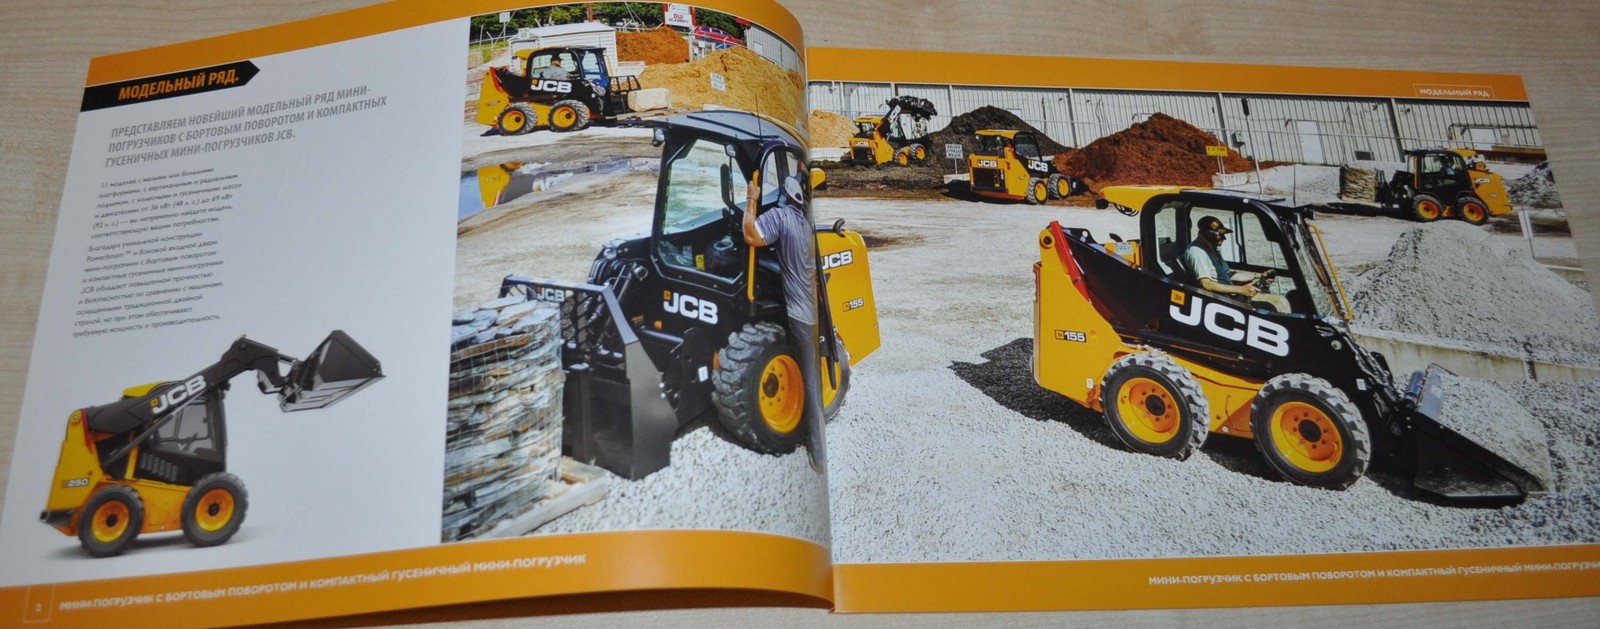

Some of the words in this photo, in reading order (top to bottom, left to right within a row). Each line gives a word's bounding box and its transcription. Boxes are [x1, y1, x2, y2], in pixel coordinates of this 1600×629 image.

[118, 74, 204, 101] МОДЕЛЬНЫЙ
[208, 68, 238, 86] РЯД.
[531, 80, 572, 93] JCB
[111, 116, 185, 138] ПРЕДСТАВЛЯЕМ
[188, 105, 244, 126] НОВЕЙШИЙ
[246, 94, 312, 116] МОДЕЛЬНЫЙ
[314, 91, 334, 105] РЯД
[336, 85, 370, 99] МИНИ-
[108, 132, 175, 154] ПОГРУЗЧИКОВ
[178, 131, 184, 142] С
[186, 122, 240, 140] БОРТОВЫМ
[244, 112, 304, 130] ПОВОРОТОМ
[306, 109, 314, 119] И
[316, 97, 387, 117] КОМПАКТНЫХ
[105, 148, 168, 168] ГУСЕНИЧНЫХ
[170, 132, 273, 158] МИНИ-ПОГРУЗЧИКОВ
[275, 129, 294, 141] JCB.
[1028, 160, 1048, 172] JCB
[822, 250, 853, 270] JCB
[80, 286, 94, 294] JCB
[537, 288, 565, 302] JCB
[849, 298, 864, 309] 155
[663, 292, 718, 325] JCB
[1064, 331, 1085, 342] 155
[1170, 296, 1289, 357] JCB
[153, 374, 206, 414] JCB
[60, 595, 153, 610] МИНИ-ПОГРУЗЧИК
[156, 593, 163, 602] С
[165, 588, 225, 602] БОРТОВЫМ
[228, 581, 297, 596] ПОВОРОТОМ
[300, 581, 307, 590] И
[309, 569, 389, 589] КОМПАКТНЫЙ
[392, 562, 470, 581] ГУСЕНИЧНЫЙ
[474, 554, 586, 572] МИНИ-ПОГРУЗЧИК
[1149, 574, 1242, 585] МИНИ-ПОГРУЗЧИК
[1244, 574, 1250, 582] С
[1253, 572, 1310, 582] БОРТОВЫМ
[1312, 570, 1375, 580] ПОВОРОТОМ
[1387, 565, 1456, 577] КОМПАКТНЫЙ
[1458, 563, 1522, 575] ГУСЕНИЧНЫЙ
